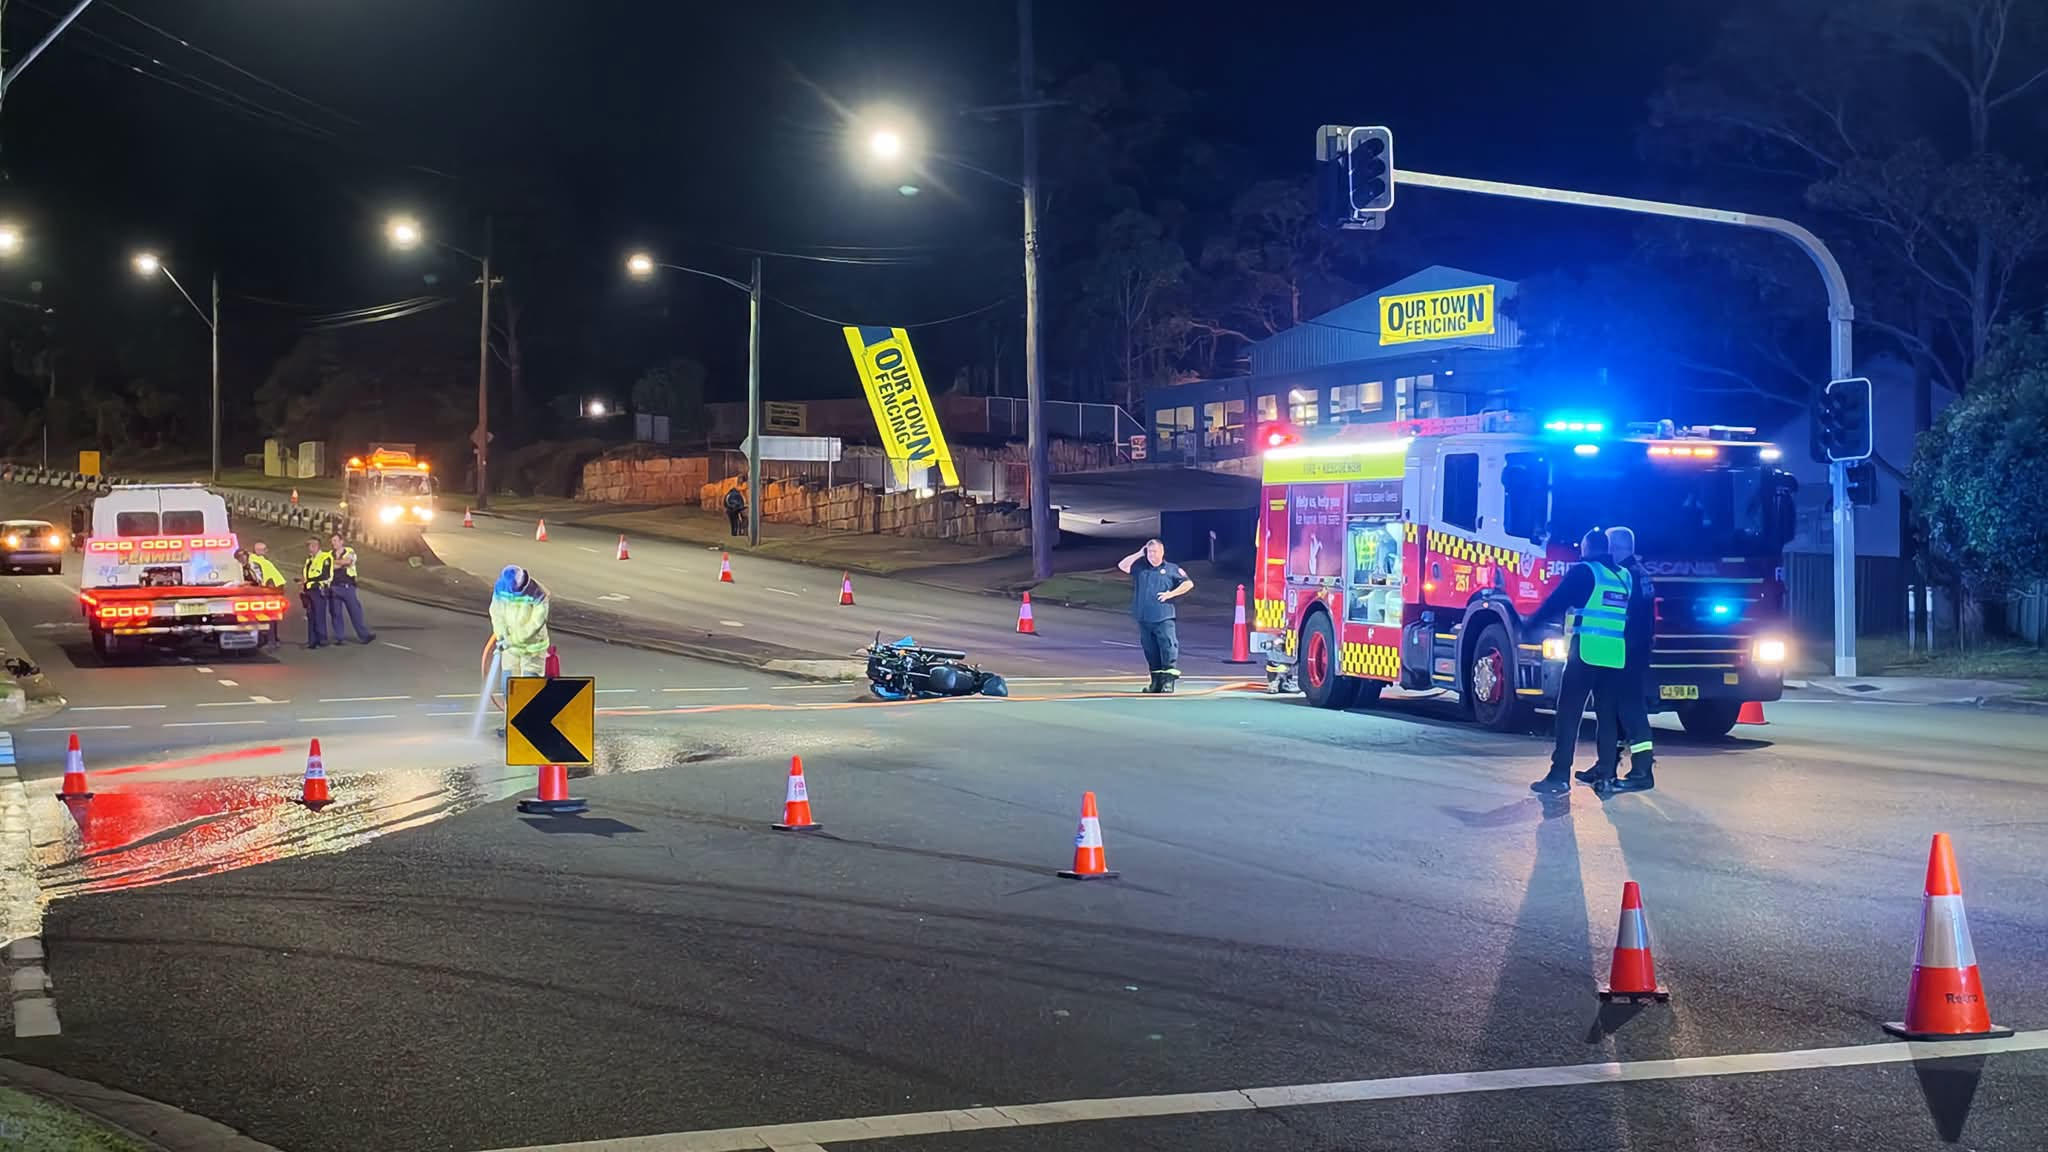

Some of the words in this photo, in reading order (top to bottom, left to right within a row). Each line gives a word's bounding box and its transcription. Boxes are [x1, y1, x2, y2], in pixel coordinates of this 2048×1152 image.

[1388, 299, 1426, 331] OUR
[1430, 292, 1485, 323] TOWN
[1405, 315, 1466, 336] FENCING
[874, 347, 912, 394] OUR
[901, 394, 936, 461] TOWN
[874, 371, 911, 444] FENCING
[1644, 560, 1718, 575] SCANIA
